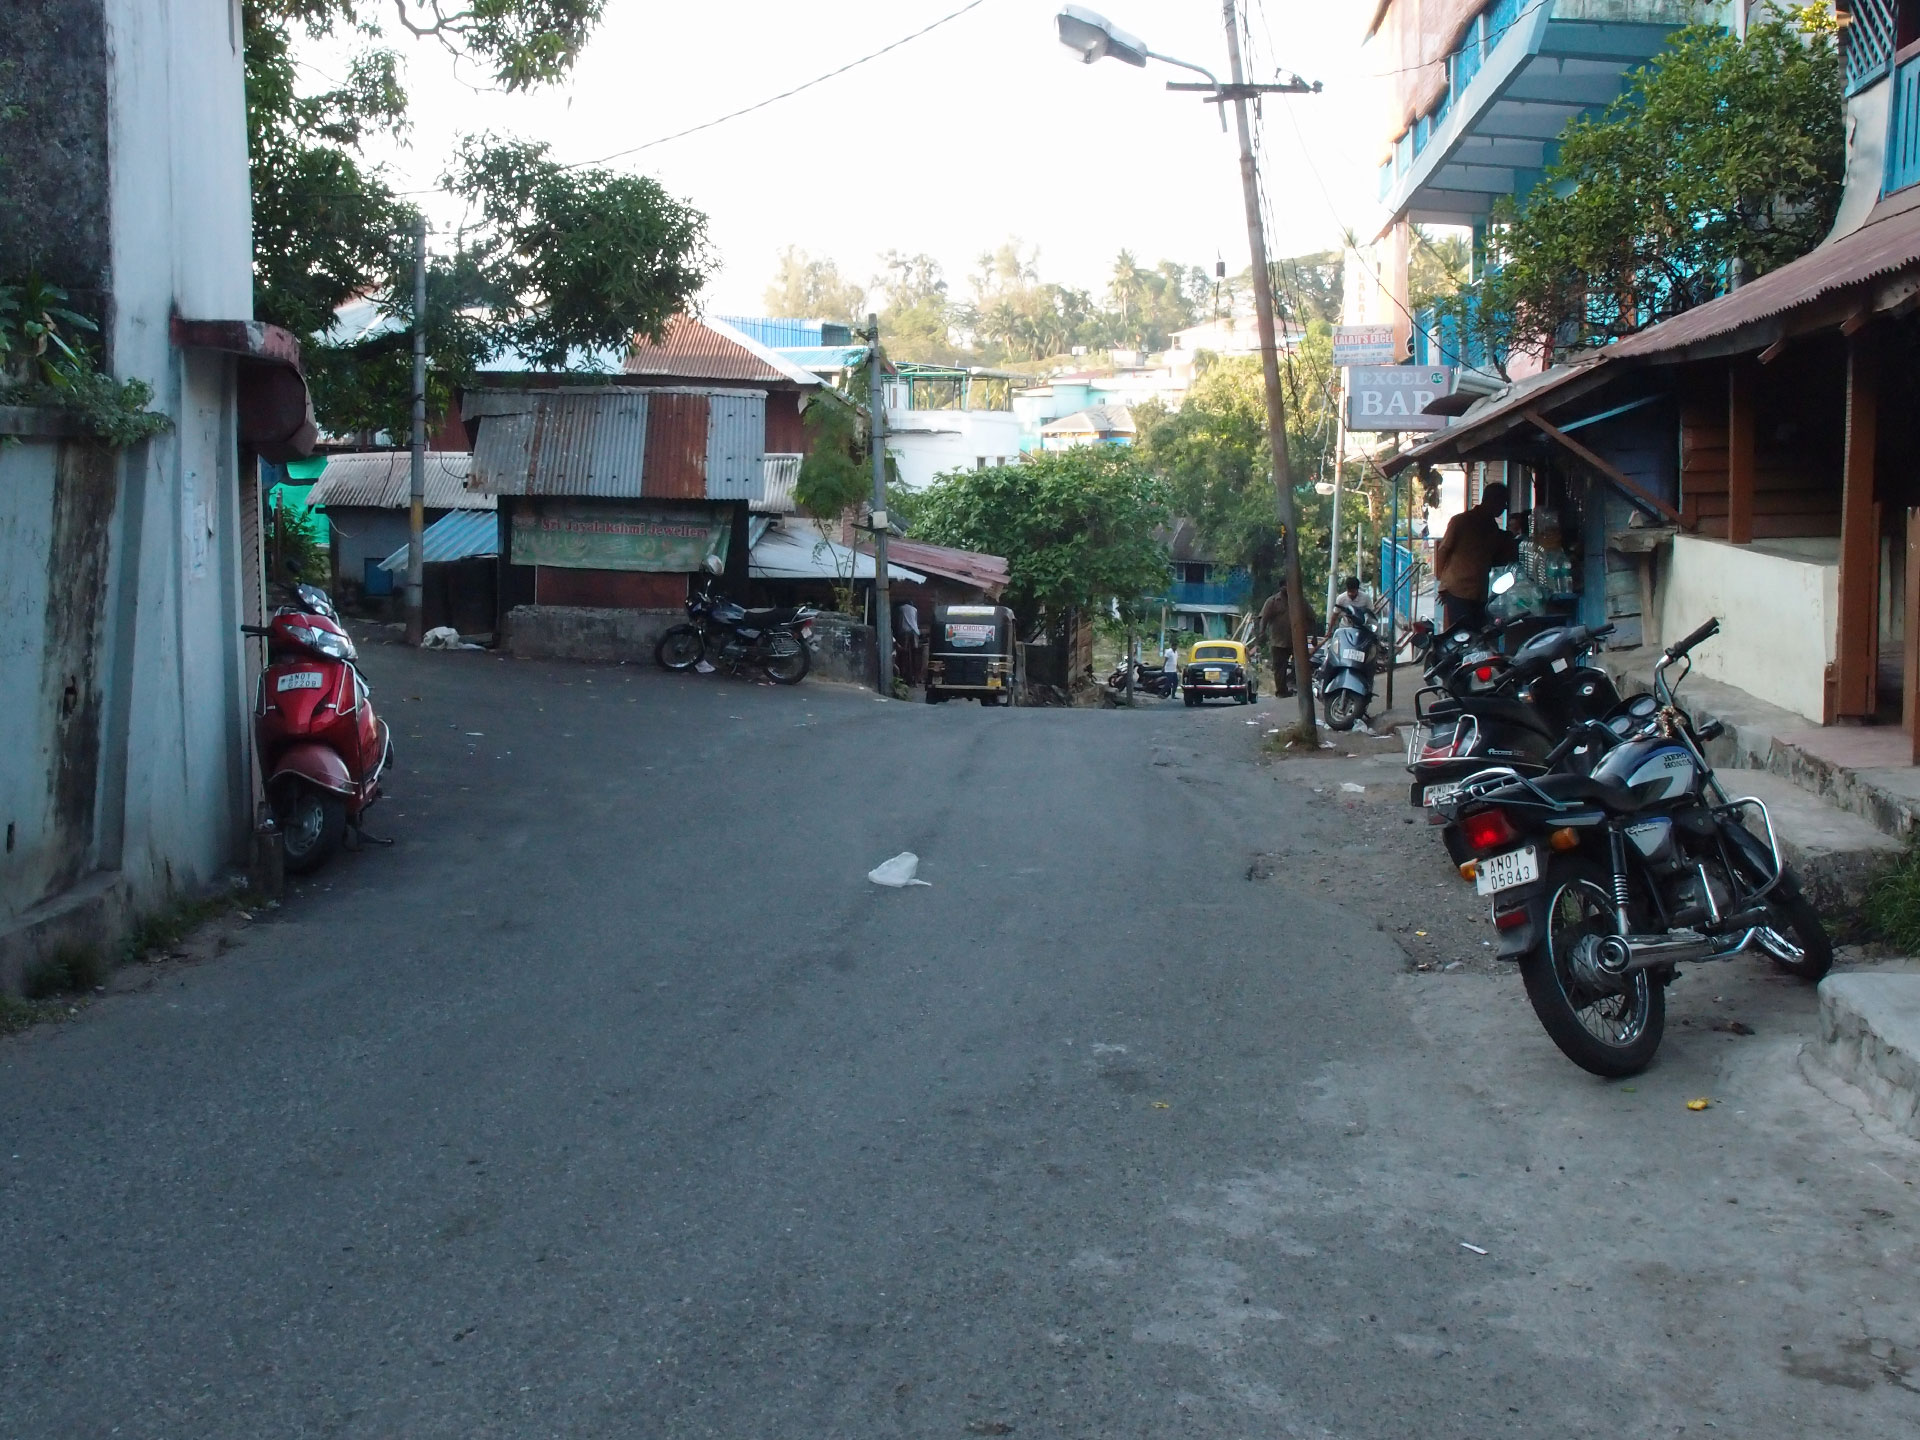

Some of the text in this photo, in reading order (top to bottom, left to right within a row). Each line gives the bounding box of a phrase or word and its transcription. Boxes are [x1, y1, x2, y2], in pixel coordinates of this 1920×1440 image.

[1359, 371, 1427, 386] EXCEL
[1360, 390, 1435, 416] BAR
[541, 518, 561, 530] Sri
[1490, 852, 1521, 875] AN01
